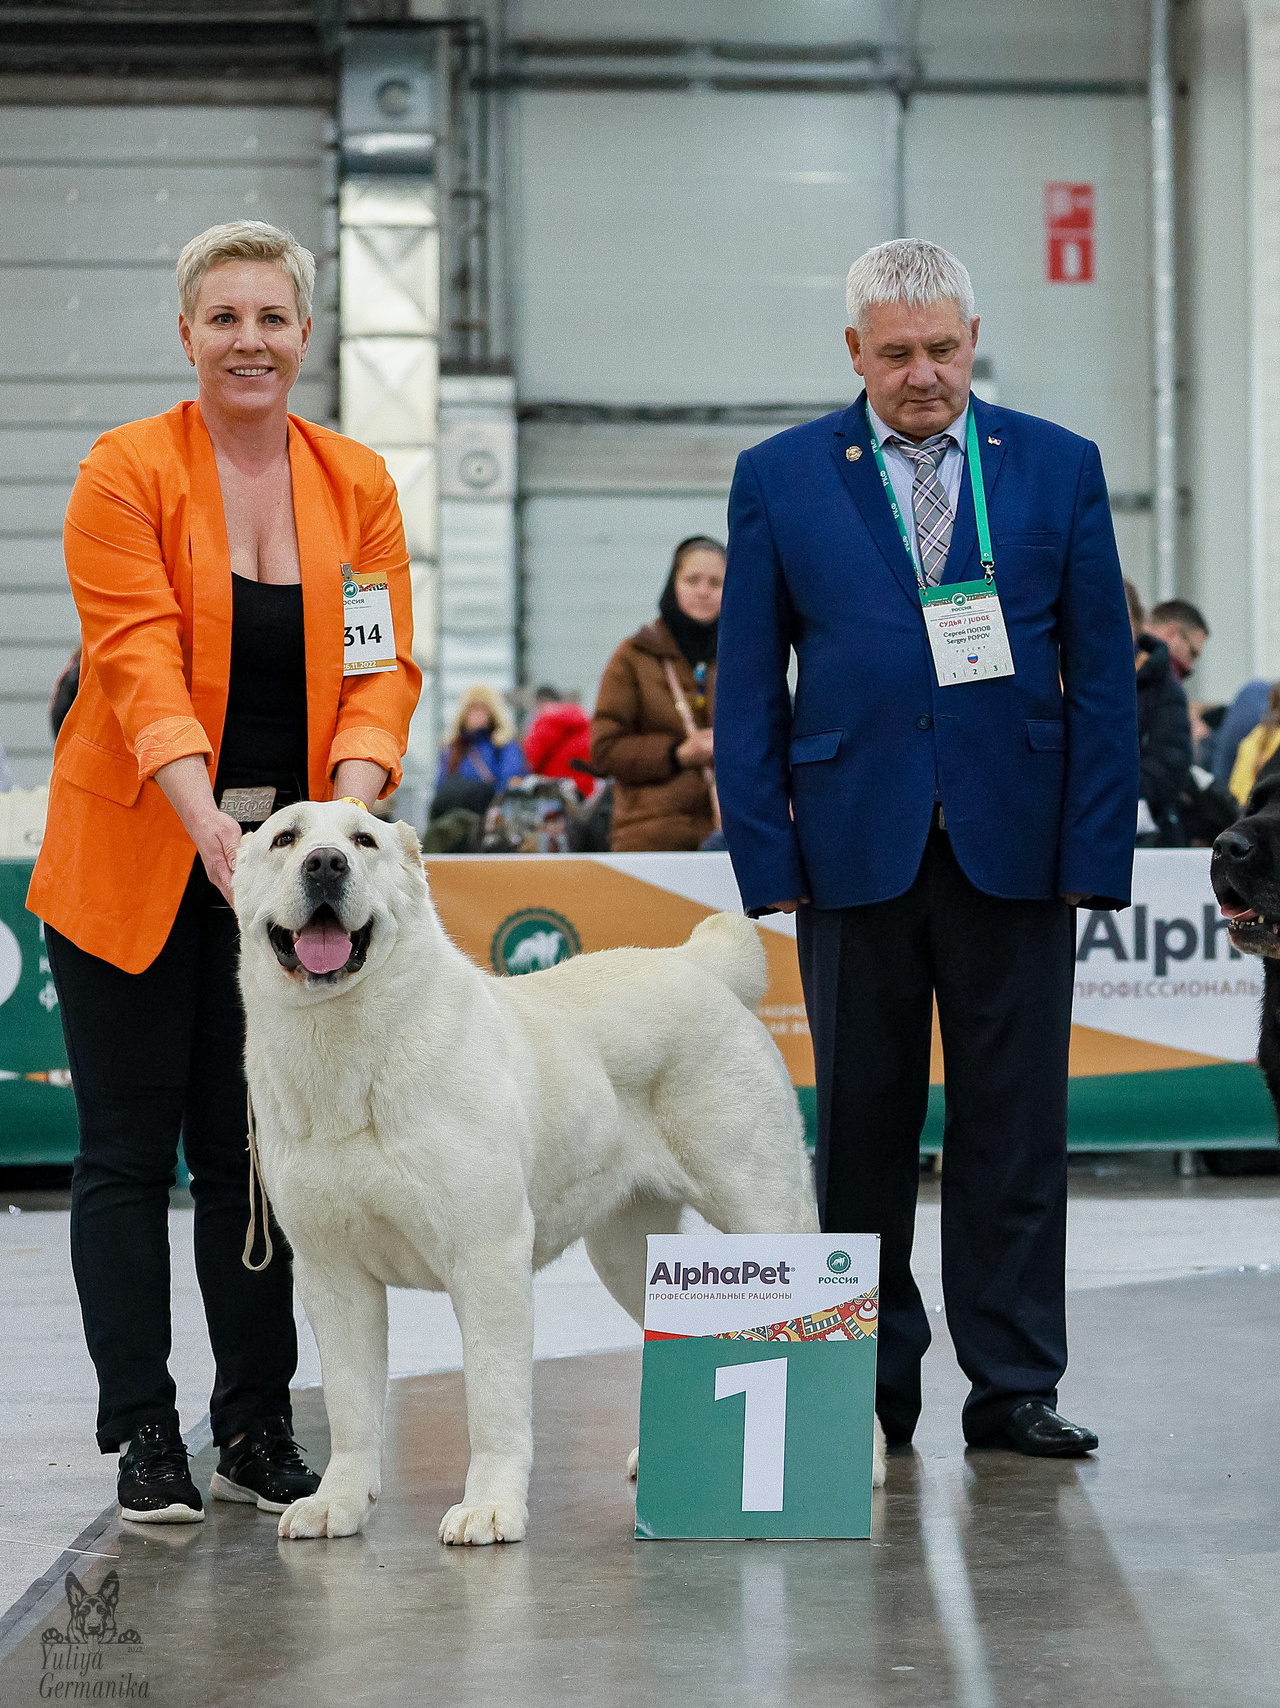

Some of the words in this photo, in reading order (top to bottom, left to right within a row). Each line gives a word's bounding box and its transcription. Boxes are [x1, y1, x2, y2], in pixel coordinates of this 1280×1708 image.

[879, 470, 888, 487] РКФ
[890, 502, 900, 520] РКФ
[939, 619, 962, 628] СУДЬЯ
[968, 614, 991, 625] JUDGE
[343, 623, 382, 647] 314
[943, 629, 966, 638] Сергей
[966, 624, 991, 634] ПОПОВ
[946, 636, 967, 645] Sergey
[968, 632, 991, 641] POPOV
[993, 664, 999, 672] 3
[649, 1261, 790, 1291] AlphaPet
[818, 1276, 859, 1285] РОССИЯ
[649, 1292, 746, 1301] ПРОФЕССИОНАЛЬНЫЕ
[748, 1292, 792, 1301] РАЦИОНЫ
[714, 1357, 788, 1512] 1
